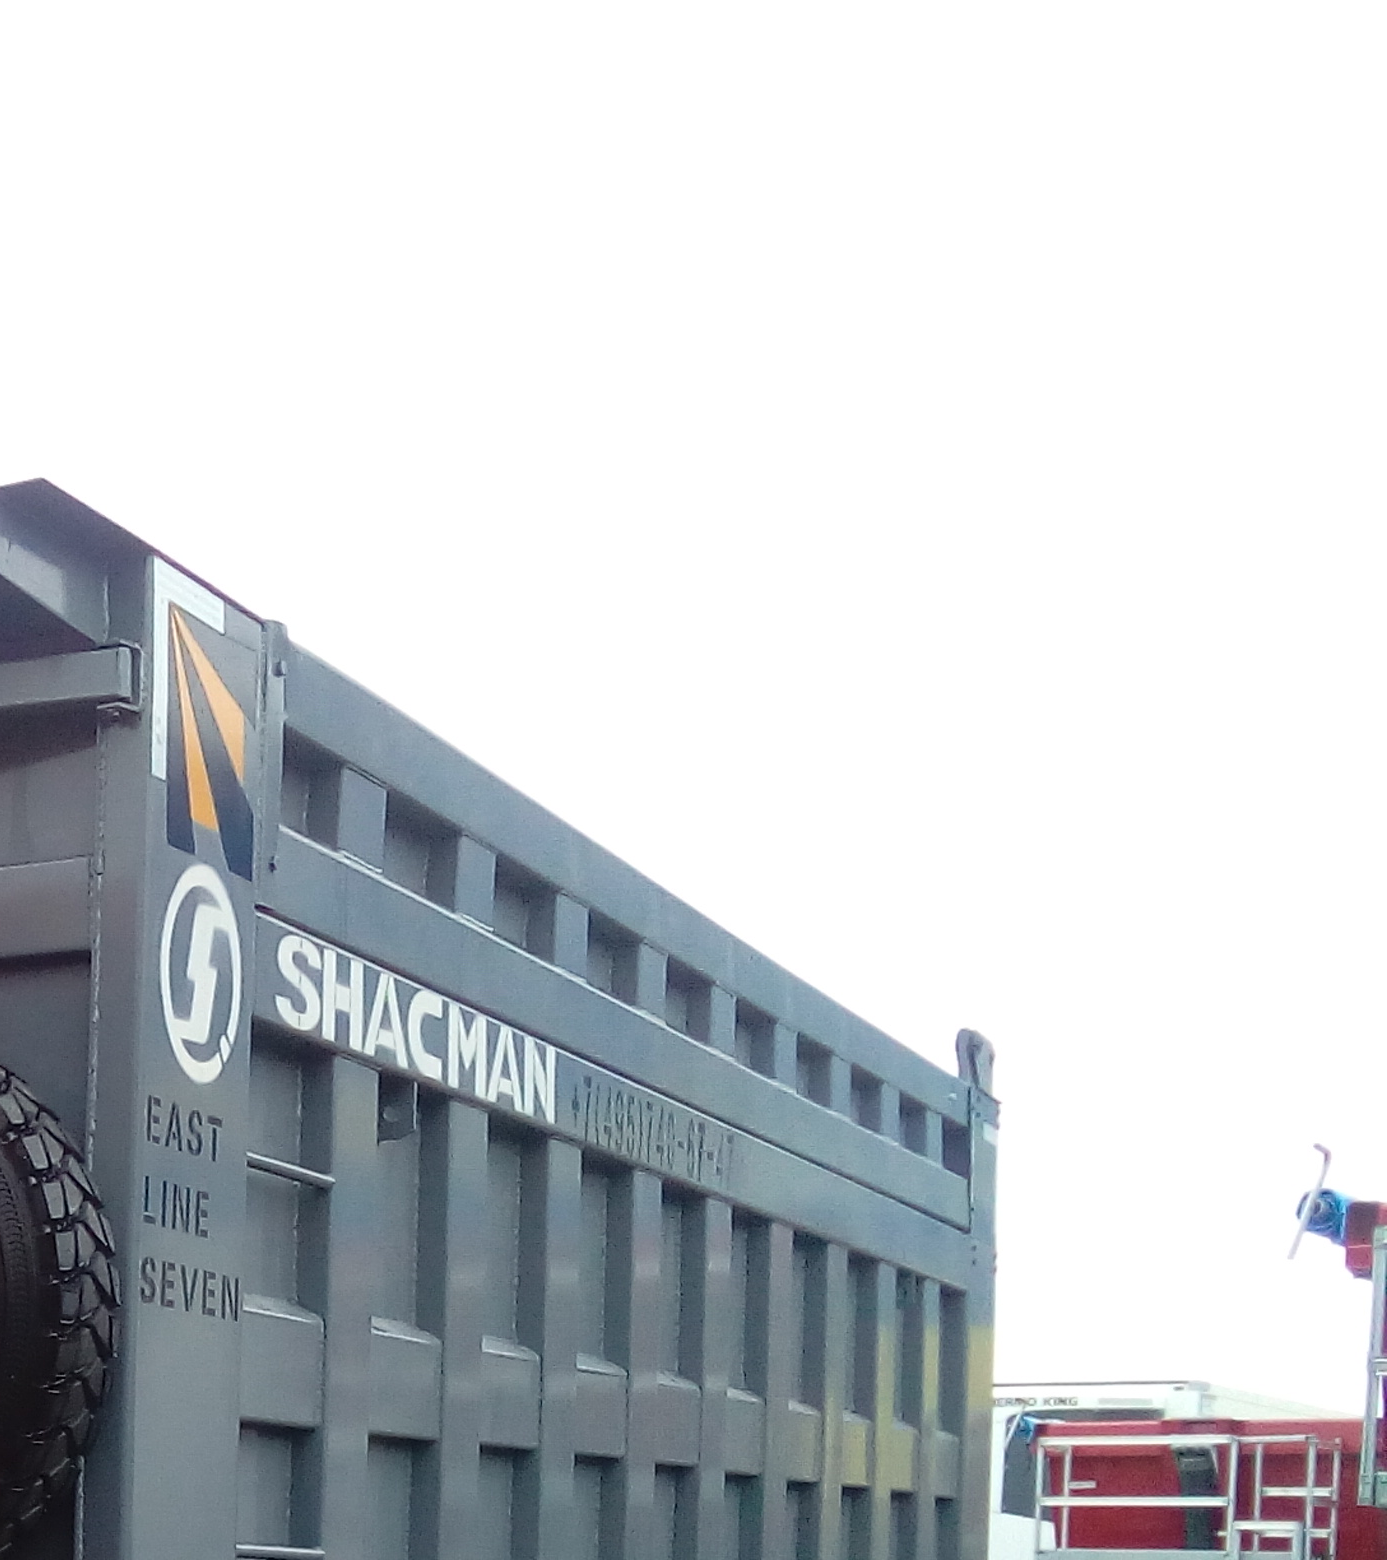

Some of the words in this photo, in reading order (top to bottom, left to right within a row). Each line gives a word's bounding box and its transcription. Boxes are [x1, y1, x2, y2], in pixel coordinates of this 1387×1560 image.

[275, 934, 556, 1124] SHACMAN
[144, 1095, 223, 1162] EAST
[143, 1175, 210, 1239] LINE
[140, 1256, 240, 1322] SEVEN
[1043, 1397, 1078, 1407] KING
